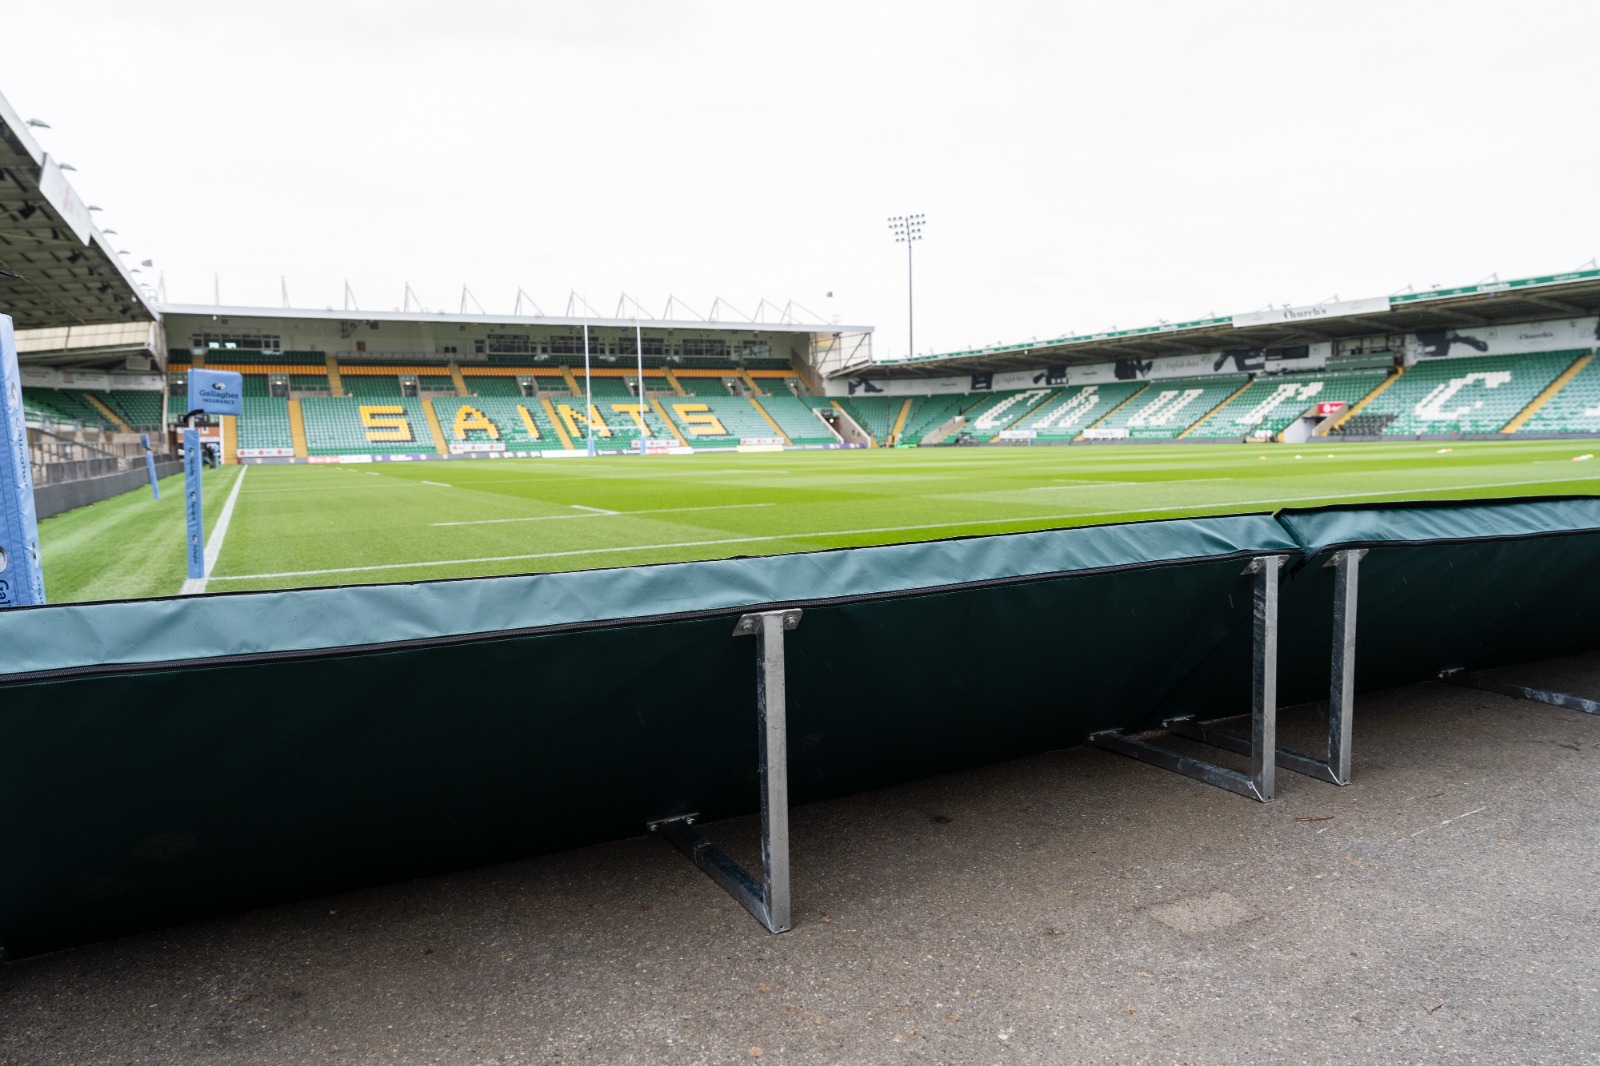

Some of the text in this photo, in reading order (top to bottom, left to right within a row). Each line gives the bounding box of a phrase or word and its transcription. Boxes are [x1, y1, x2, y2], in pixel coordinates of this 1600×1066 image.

[1283, 306, 1327, 319] Church's
[199, 389, 239, 399] Gallagher
[359, 403, 732, 443] SAINTS
[16, 417, 28, 489] Gallagher
